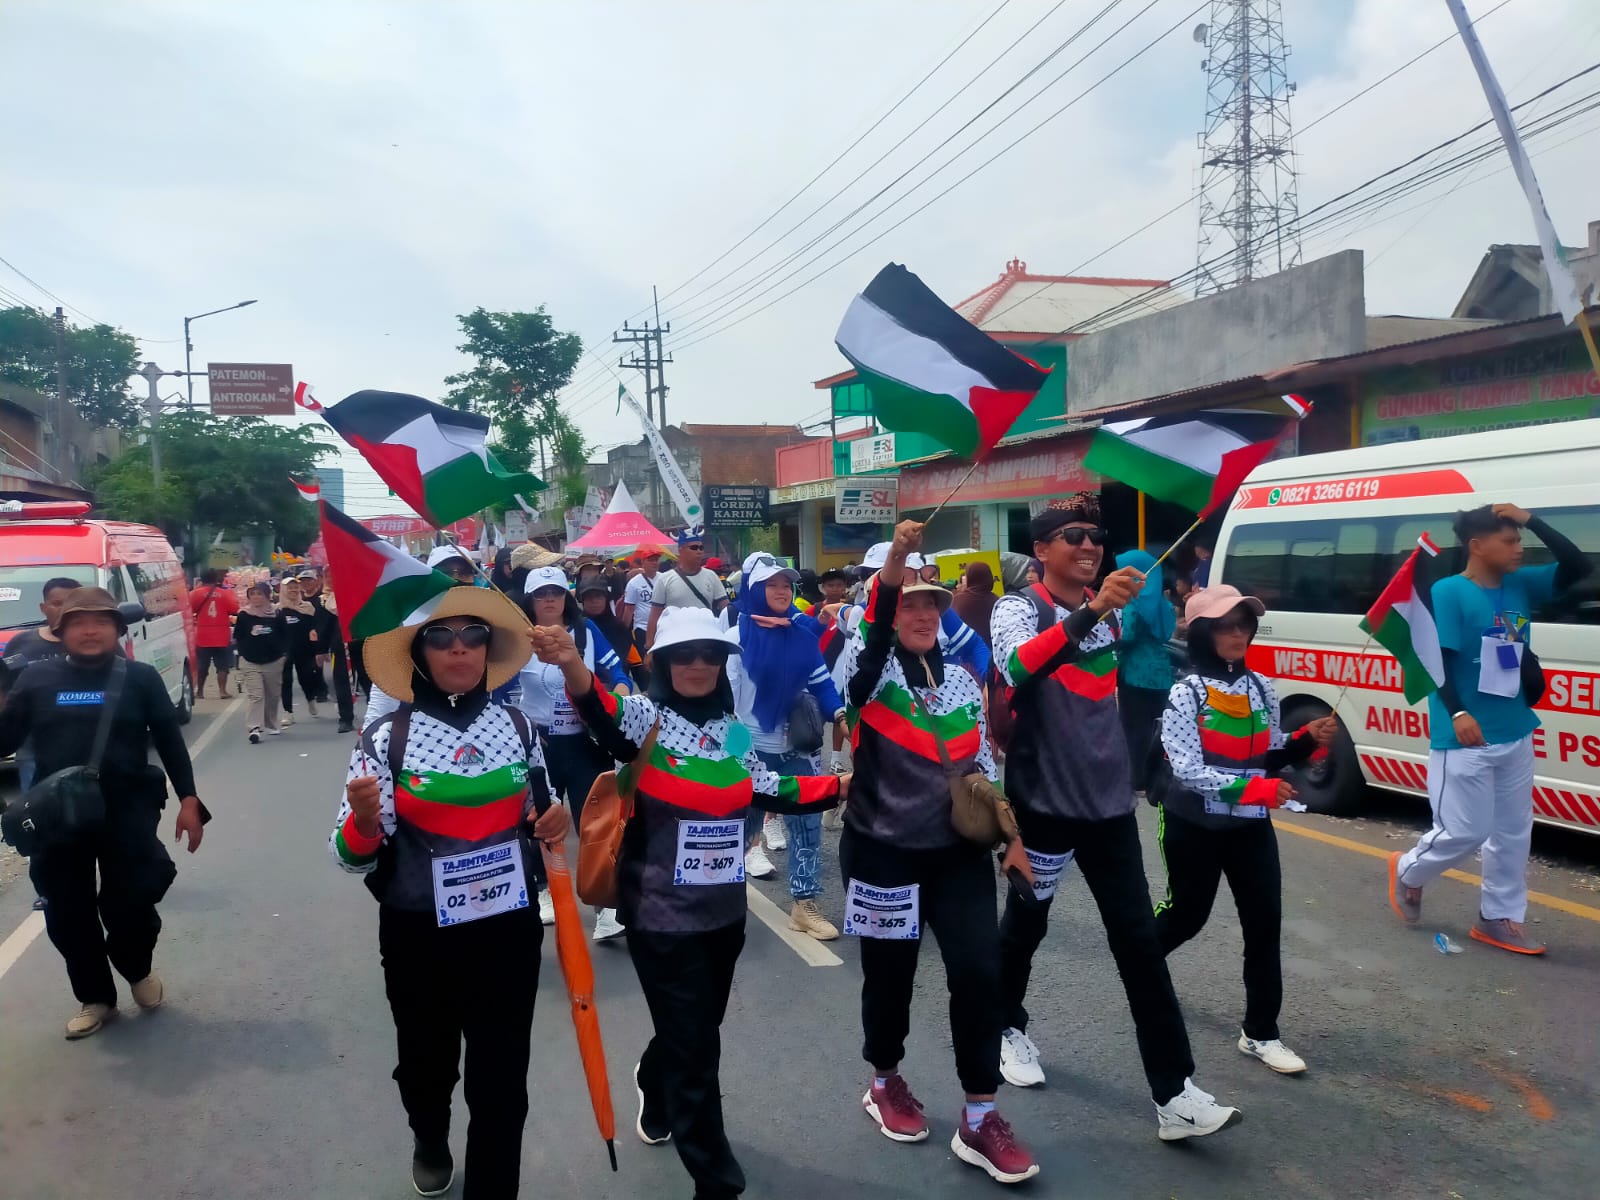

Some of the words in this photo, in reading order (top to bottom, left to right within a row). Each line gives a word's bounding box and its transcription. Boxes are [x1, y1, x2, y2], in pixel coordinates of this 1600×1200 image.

[210, 369, 266, 380] PATEMON
[212, 392, 276, 402] ANTROKAN
[1376, 392, 1456, 420] GUNUNG
[1282, 487, 1309, 503] 0821
[1312, 484, 1343, 500] 3266
[1345, 479, 1379, 498] 6119
[712, 501, 763, 509] LORENA
[714, 510, 761, 518] KARINA
[840, 507, 892, 518] Express
[372, 521, 414, 531] START
[207, 600, 217, 618] 4
[1274, 650, 1317, 678] WES
[1322, 654, 1402, 689] WAYAH
[58, 692, 102, 701] KOMPAS
[442, 852, 496, 870] TAJEMTRA
[684, 858, 700, 870] 02
[710, 857, 734, 870] 3679
[447, 894, 466, 908] 02
[480, 882, 511, 902] 3677
[853, 914, 868, 925] 02
[878, 918, 907, 928] 3675
